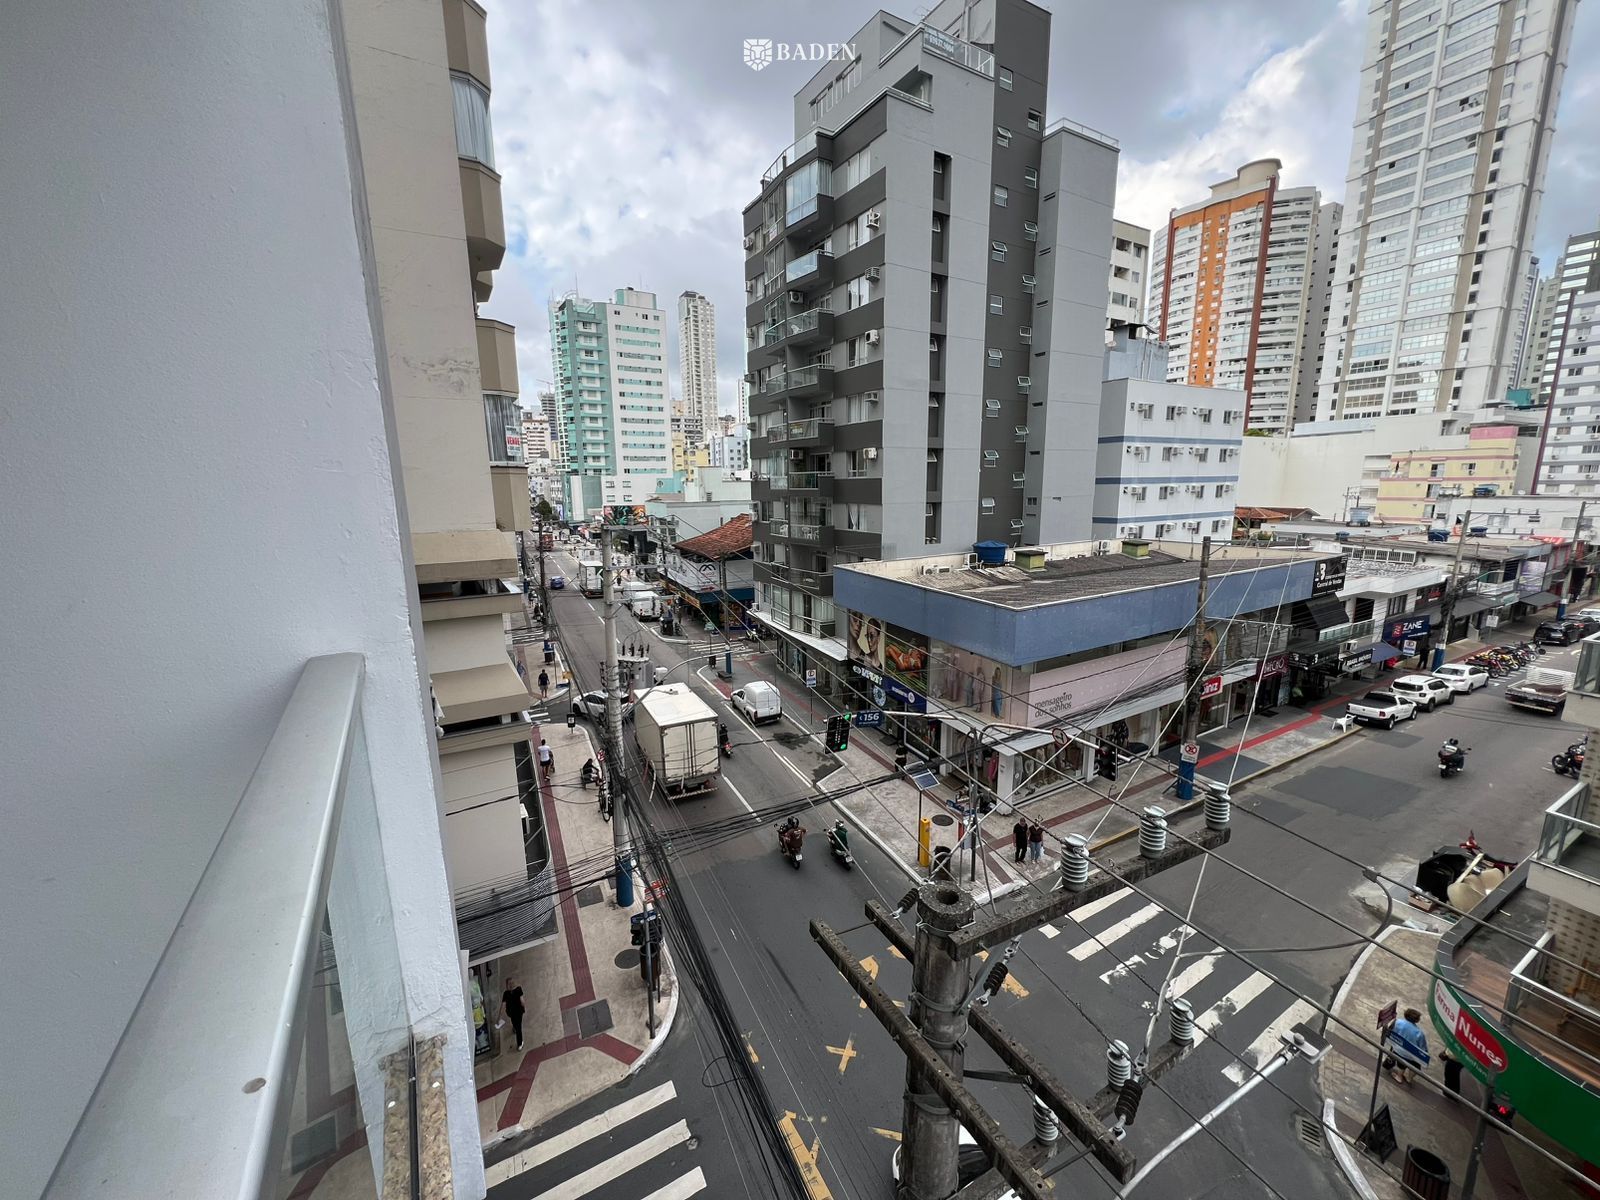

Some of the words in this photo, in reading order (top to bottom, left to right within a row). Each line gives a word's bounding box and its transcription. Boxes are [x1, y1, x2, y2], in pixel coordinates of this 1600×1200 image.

[1402, 620, 1424, 631] ZANE
[1035, 692, 1073, 709] mensageiro
[1049, 701, 1072, 713] sonhos
[863, 712, 880, 722] 156
[1458, 1016, 1504, 1068] Nunes
